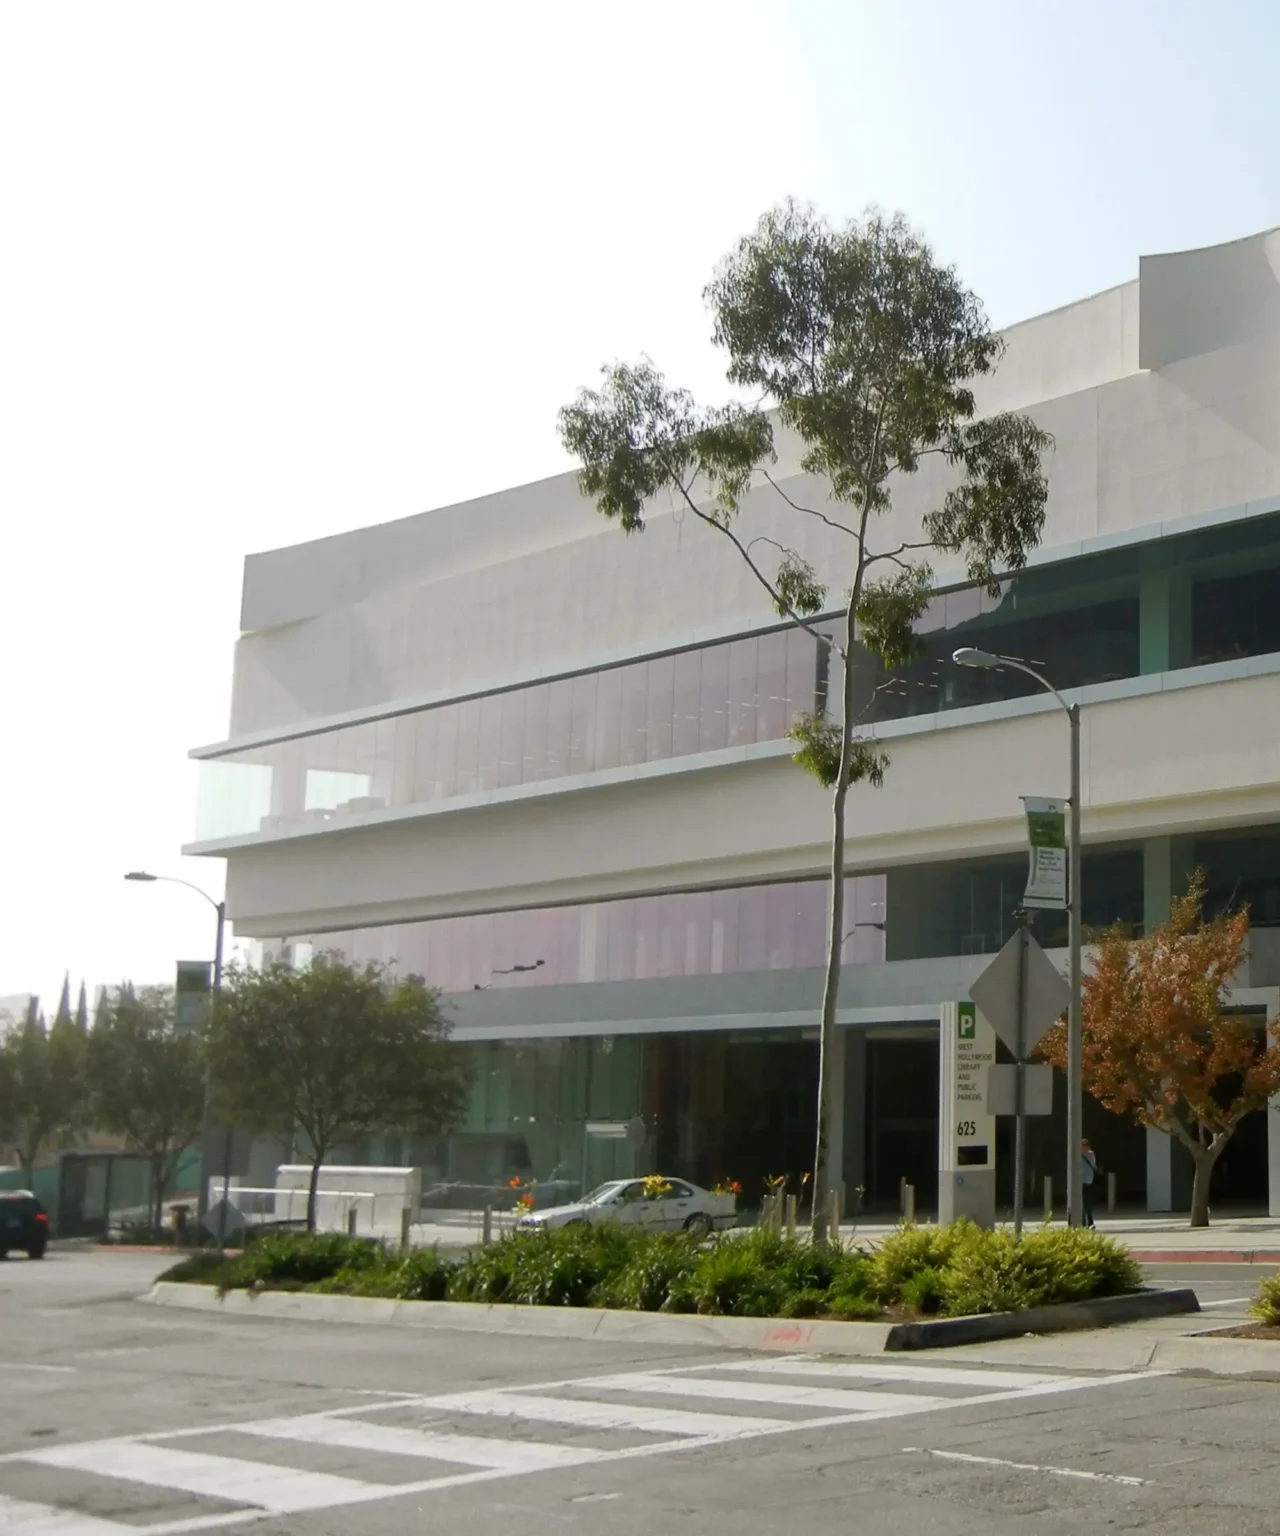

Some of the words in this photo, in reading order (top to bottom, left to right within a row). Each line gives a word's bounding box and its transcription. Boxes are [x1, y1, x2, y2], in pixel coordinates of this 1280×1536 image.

[960, 1014, 973, 1035] P
[957, 1093, 982, 1101] PARKING
[957, 1121, 976, 1136] 625
